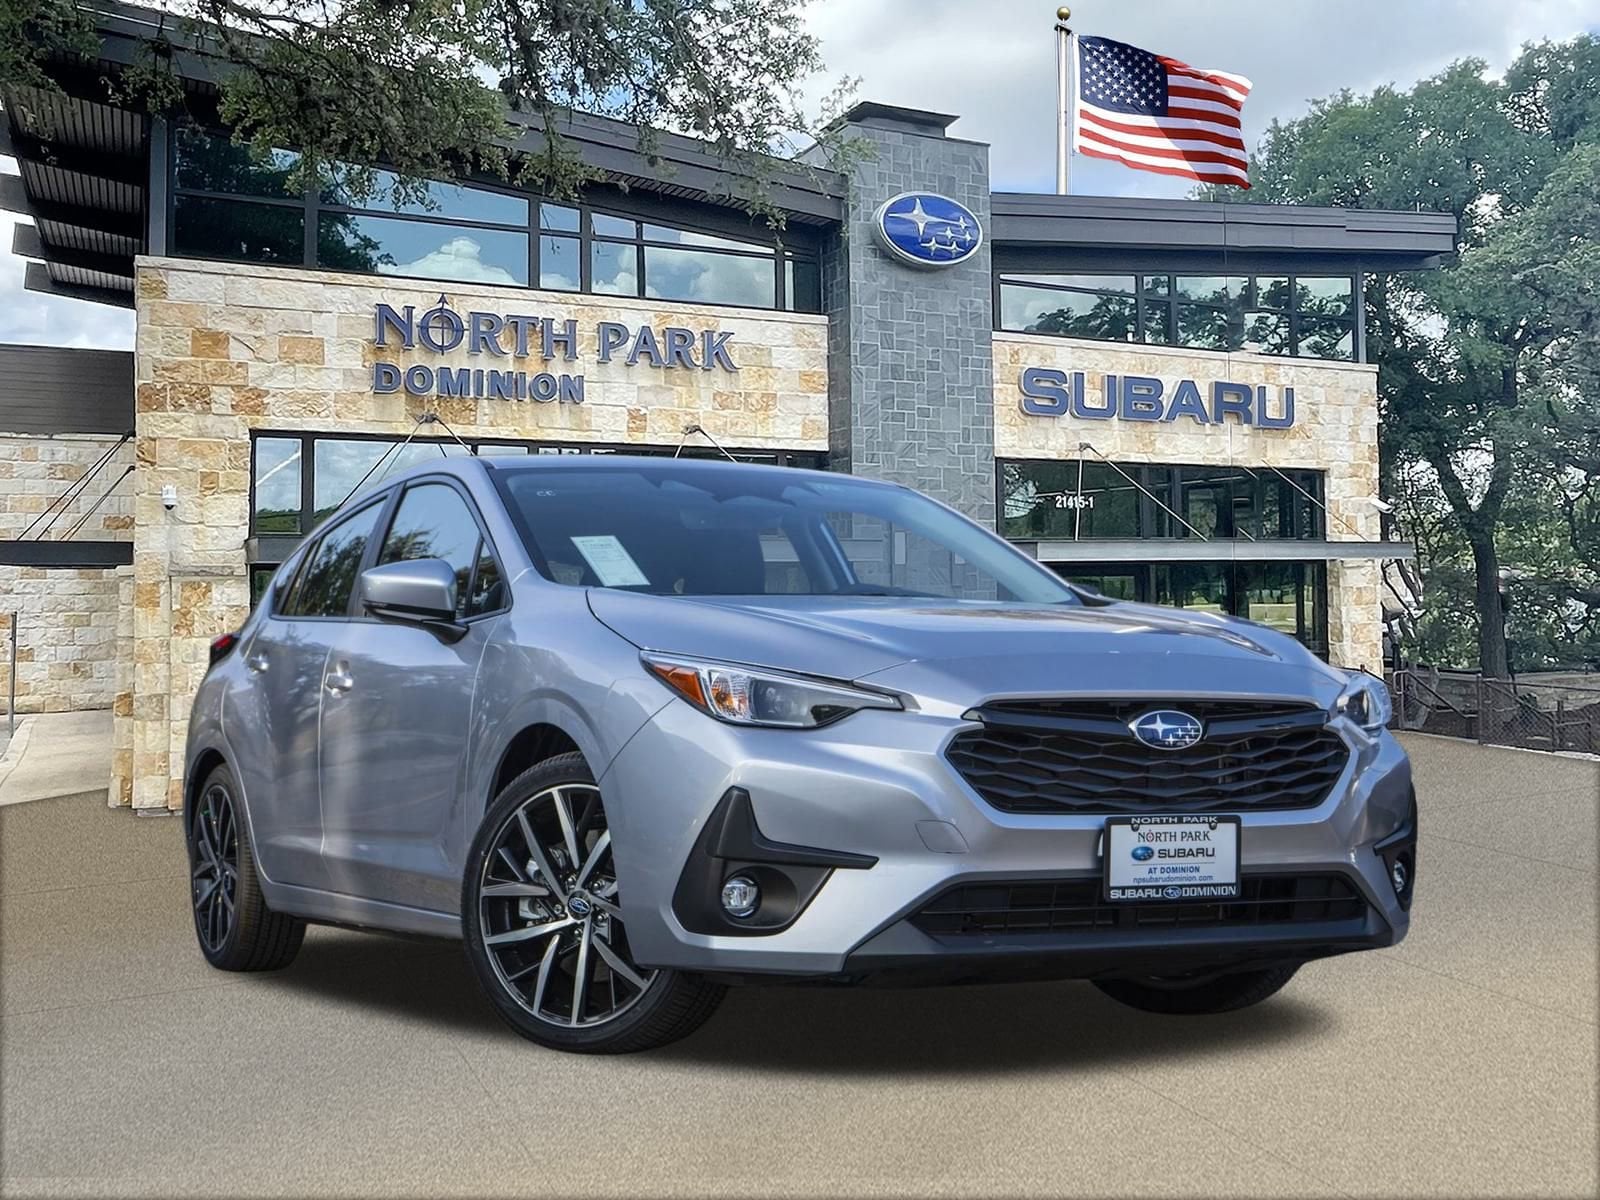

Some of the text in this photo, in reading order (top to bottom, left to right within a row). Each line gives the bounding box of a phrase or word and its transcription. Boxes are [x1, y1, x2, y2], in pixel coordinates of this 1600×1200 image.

[374, 296, 742, 372] NORTH PARK
[373, 362, 586, 405] DOMINION
[1018, 366, 1295, 430] SUBARU
[1131, 816, 1218, 824] NORTH PARK
[1138, 830, 1212, 843] NORTH PARK
[1158, 847, 1216, 859] SUBARU
[1148, 866, 1200, 875] AT DOMINION
[1133, 874, 1214, 884] npsubarudominion.com
[1110, 885, 1237, 899] SUBARU DOMINION
